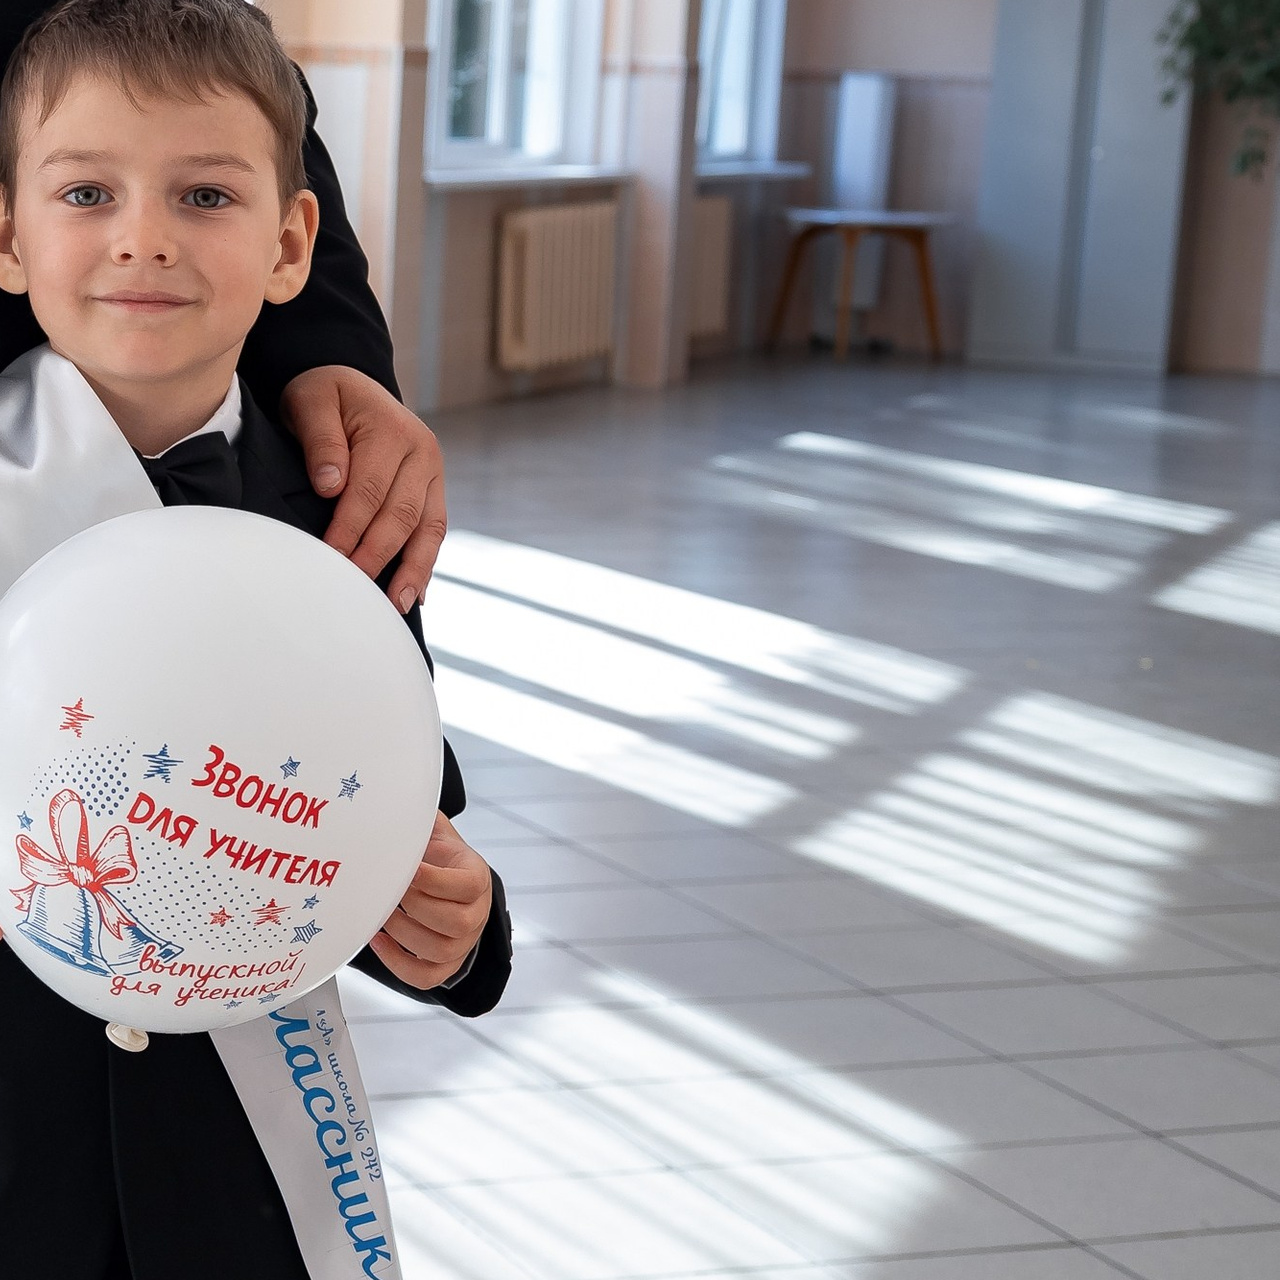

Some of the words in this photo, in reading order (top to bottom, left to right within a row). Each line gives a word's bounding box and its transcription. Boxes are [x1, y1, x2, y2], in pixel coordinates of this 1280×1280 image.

[191, 744, 330, 830] ЗВОНОК
[126, 791, 199, 849] ДЛЯ
[202, 827, 342, 888] УЧИТЕЛЯ
[109, 975, 162, 997] для
[173, 962, 307, 1007] ученика!
[139, 944, 304, 989] выпускной
[327, 1052, 358, 1119] школа
[360, 1146, 382, 1183] 242
